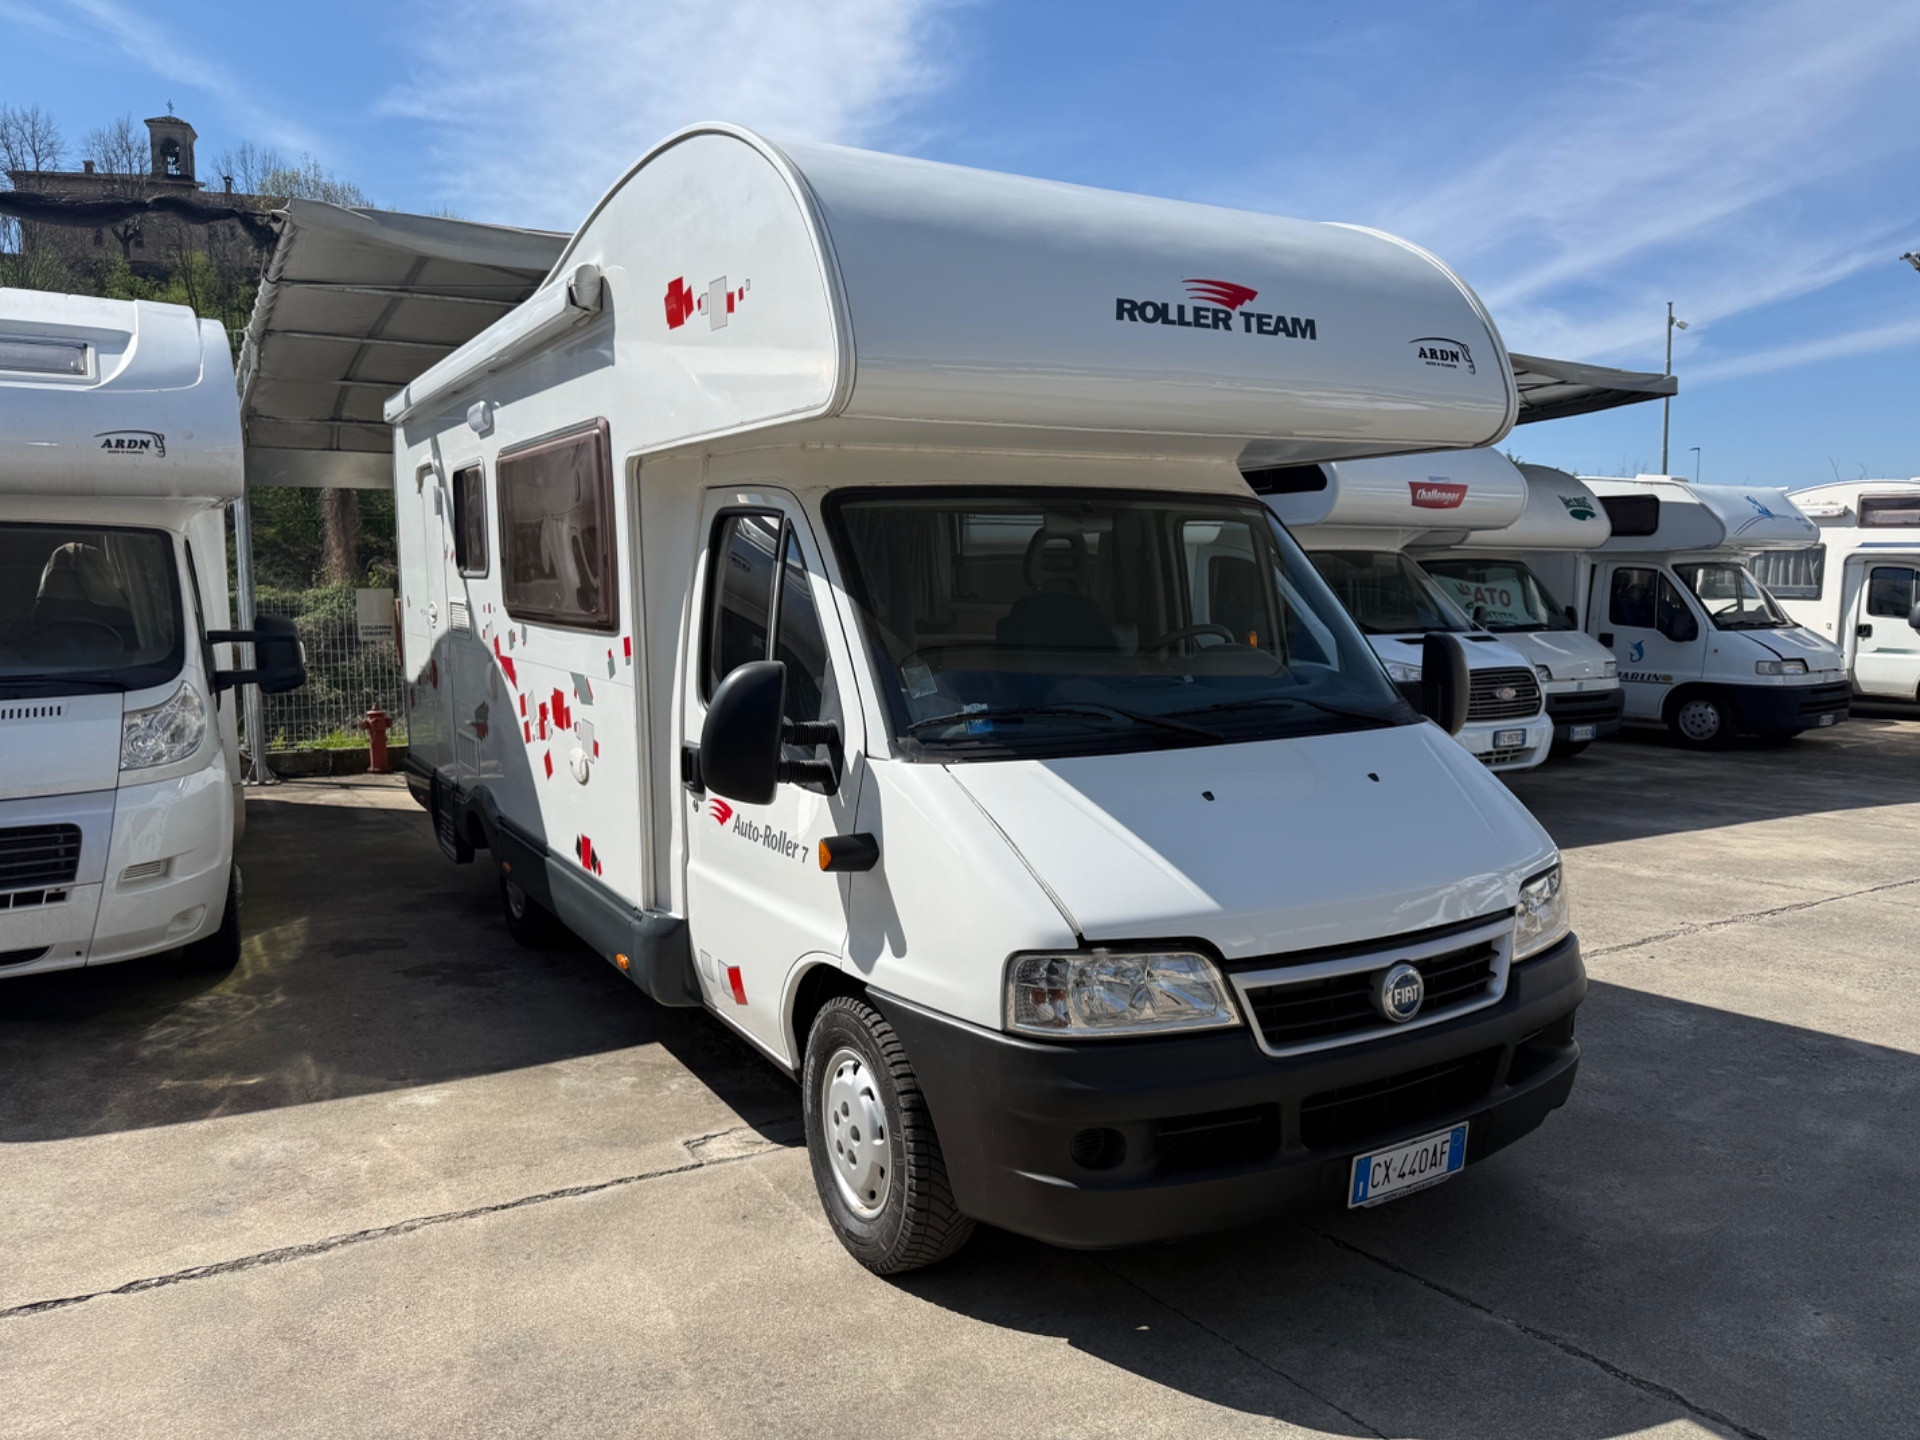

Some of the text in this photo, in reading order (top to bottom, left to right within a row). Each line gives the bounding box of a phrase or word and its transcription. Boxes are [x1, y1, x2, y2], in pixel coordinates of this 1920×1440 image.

[1115, 297, 1317, 341] ROLLER TEAM
[1418, 346, 1460, 363] ARDN
[101, 437, 152, 450] ARDN
[1416, 487, 1461, 505] Challenger
[732, 813, 809, 864] Auto-Roller 7
[1393, 984, 1419, 1006] FIAT
